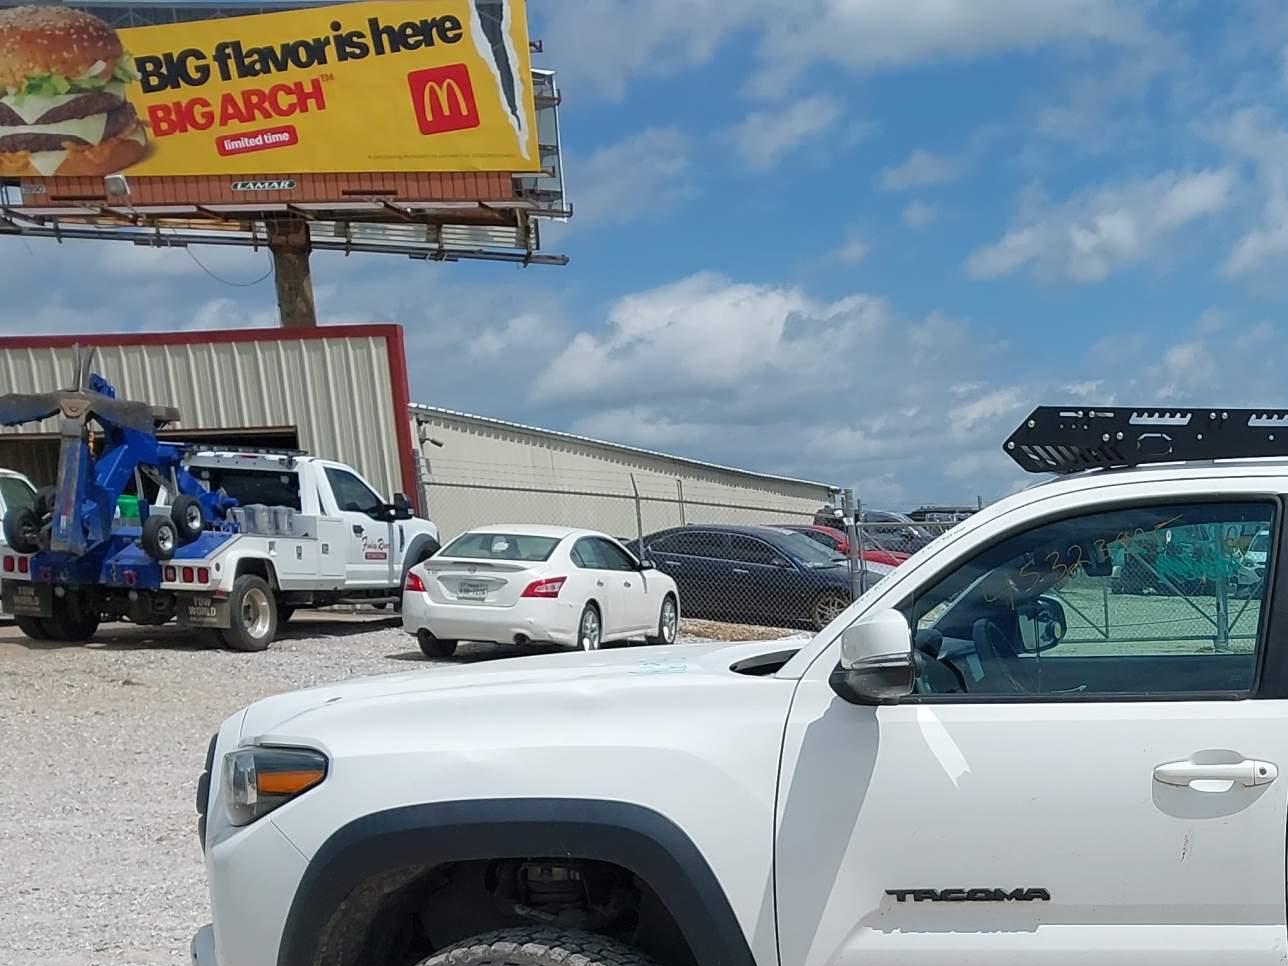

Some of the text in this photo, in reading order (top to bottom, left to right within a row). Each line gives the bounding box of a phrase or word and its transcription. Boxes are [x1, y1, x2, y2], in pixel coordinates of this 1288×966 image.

[134, 14, 464, 94] BIG flavor is here
[147, 97, 215, 138] BIG
[223, 132, 290, 151] limited time
[236, 180, 290, 191] LAMAR
[188, 606, 217, 617] WORLD
[884, 887, 1051, 903] TACOMA
